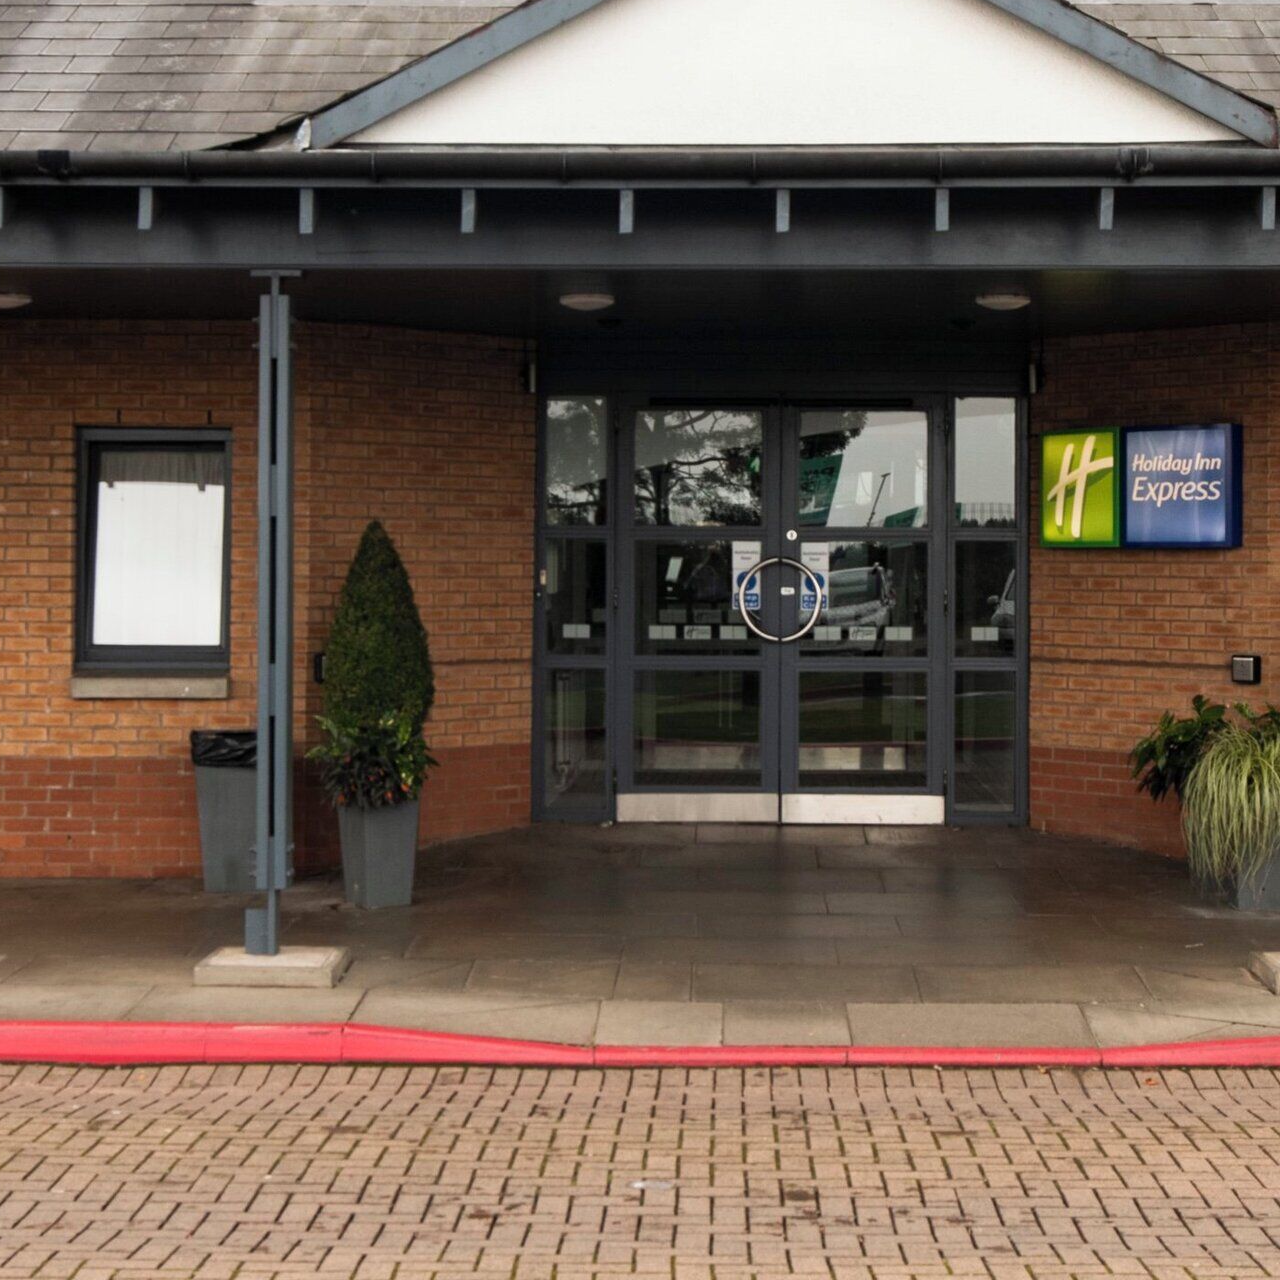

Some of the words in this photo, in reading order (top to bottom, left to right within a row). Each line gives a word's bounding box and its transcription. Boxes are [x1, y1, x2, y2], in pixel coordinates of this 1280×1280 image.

[1132, 453, 1193, 475] Holiday
[1194, 452, 1222, 471] Inn
[1132, 476, 1222, 508] Express
